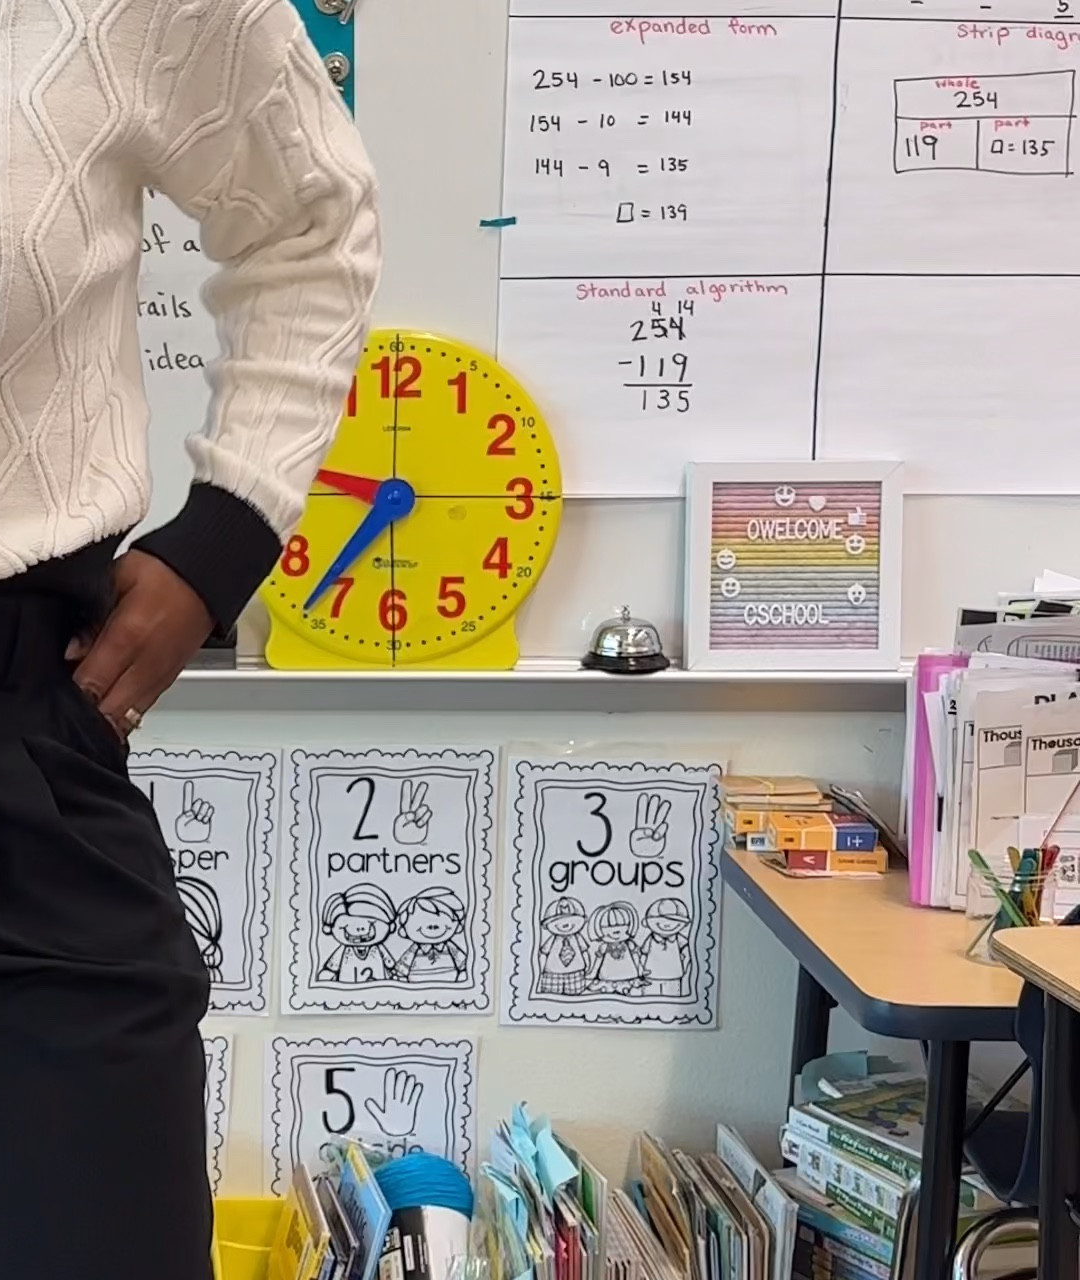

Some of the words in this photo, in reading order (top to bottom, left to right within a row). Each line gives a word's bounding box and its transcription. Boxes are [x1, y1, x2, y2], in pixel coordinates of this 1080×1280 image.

[610, 18, 712, 45] expanded
[728, 18, 778, 36] form
[957, 24, 1010, 46] Strip
[532, 69, 579, 90] 254
[662, 70, 692, 86] 154
[954, 90, 998, 109] 254
[529, 114, 561, 133] 154
[600, 113, 616, 129] 10
[664, 110, 692, 126] 144
[920, 121, 953, 132] part
[994, 117, 1031, 132] part
[905, 134, 938, 161] 119
[1022, 138, 1056, 157] 135
[535, 157, 564, 177] 144
[597, 159, 610, 177] 9
[660, 156, 689, 173] 135
[660, 203, 688, 222] 139
[576, 281, 667, 300] Standard
[686, 280, 789, 302] algorithm
[145, 342, 205, 371] idea
[370, 356, 422, 398] 12
[447, 371, 467, 414] 1
[642, 389, 690, 412] 135
[486, 413, 516, 456] 2
[505, 477, 535, 520] 3
[281, 535, 310, 577] 8
[482, 537, 512, 579] 4
[516, 566, 532, 578] 20
[329, 577, 355, 619] 7
[378, 588, 408, 632] 6
[436, 576, 466, 619] 5
[311, 618, 327, 630] 35
[461, 621, 476, 632] 25
[346, 776, 379, 841] 2
[577, 791, 614, 858] 3
[327, 849, 461, 877] partners
[549, 859, 686, 892] groups
[322, 1067, 357, 1134] 5
